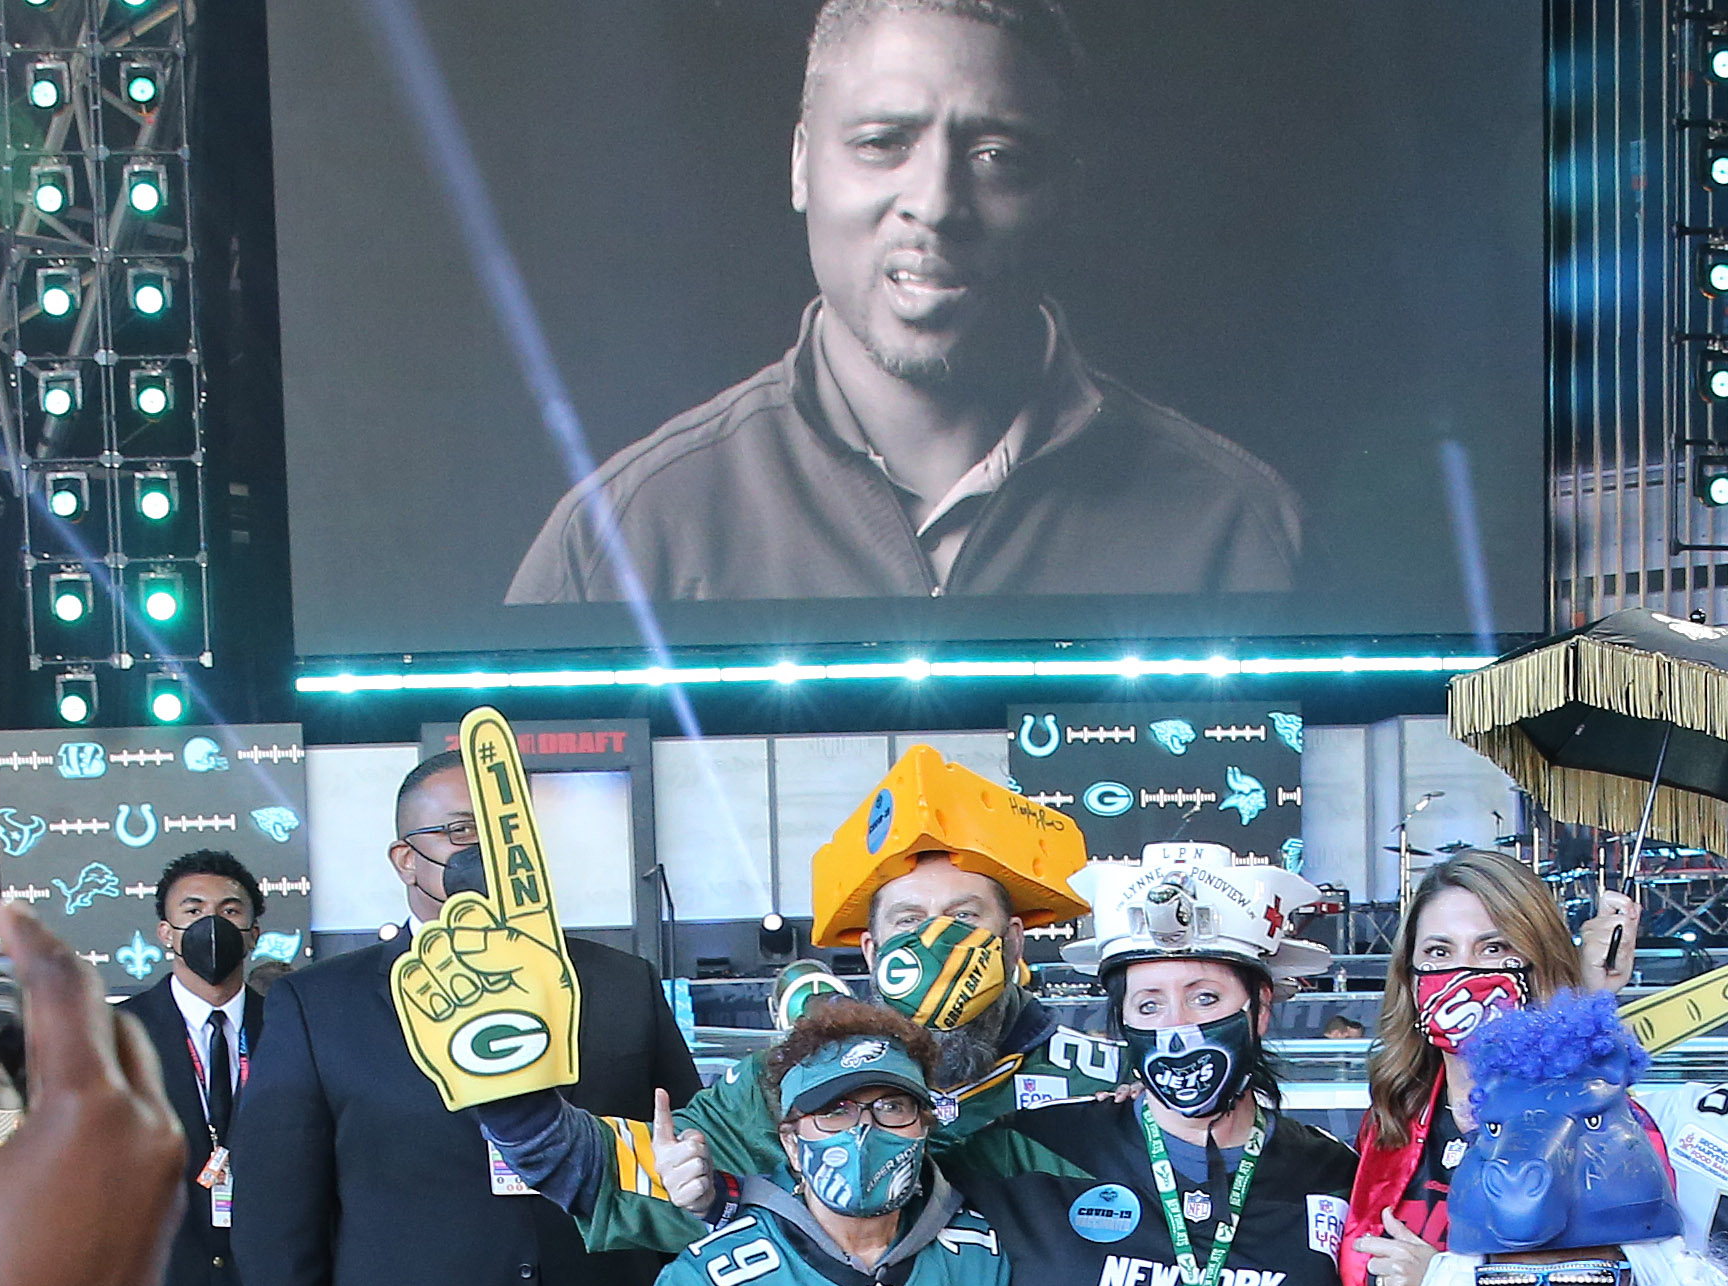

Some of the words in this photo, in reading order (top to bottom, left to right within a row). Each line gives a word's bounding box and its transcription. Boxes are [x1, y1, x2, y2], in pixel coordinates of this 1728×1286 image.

[538, 731, 627, 755] DRAFT
[478, 741, 515, 806] #1
[498, 812, 541, 908] FAN
[1123, 867, 1165, 901] LYNNE
[1190, 866, 1251, 909] PONDVIEW
[943, 990, 968, 1029] GREEN
[1154, 1063, 1215, 1089] JETS
[1077, 1206, 1133, 1220] COVID-19
